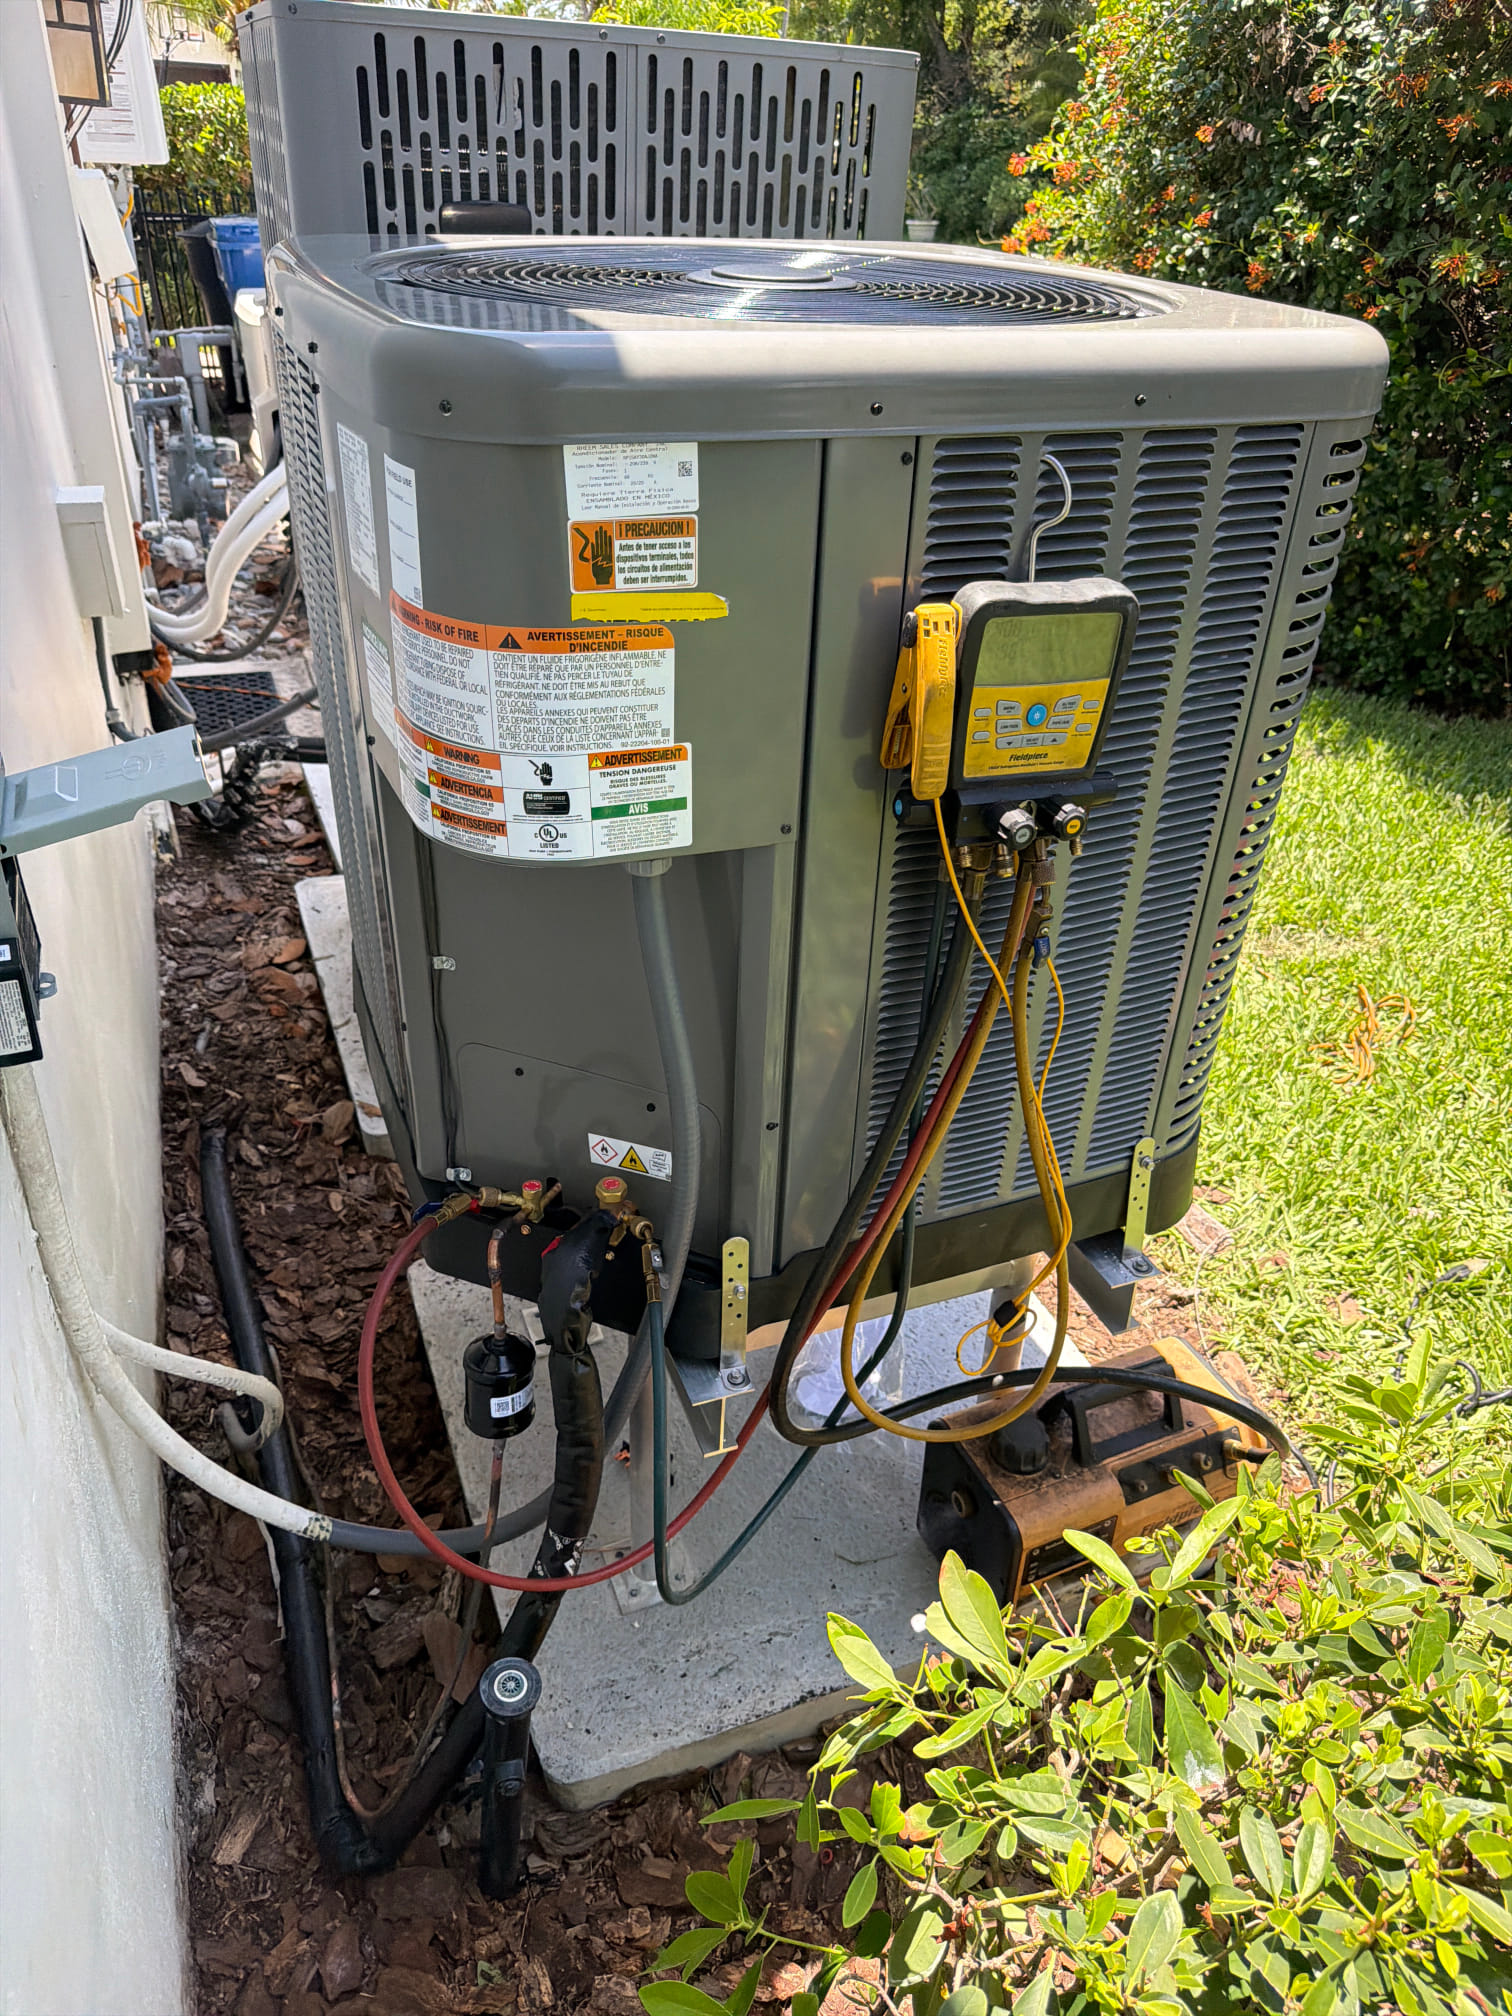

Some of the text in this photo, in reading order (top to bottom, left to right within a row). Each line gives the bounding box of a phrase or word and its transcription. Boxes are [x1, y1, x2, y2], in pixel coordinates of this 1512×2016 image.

[624, 521, 684, 538] PRECAUCION
[618, 543, 634, 552] Antes
[636, 542, 642, 550] de
[644, 542, 657, 550] tener
[658, 542, 677, 550] acceso
[683, 540, 691, 548] los
[616, 553, 648, 564] dispositivos
[680, 551, 694, 560] todos
[618, 562, 692, 574] los circuitos de alimentación
[623, 573, 688, 584] deben ser interrumpidos.
[425, 619, 442, 634] RISK
[444, 625, 456, 637] OF
[458, 628, 480, 643] FIRE
[527, 628, 664, 642] AVERTISSEMENT RISQUE
[448, 644, 474, 659] REPAIRED
[569, 640, 628, 653] D'INCENDIE
[449, 656, 457, 667] DO
[458, 658, 470, 670] NOT
[492, 652, 526, 664] CONTIENT
[528, 655, 538, 664] UN
[540, 655, 563, 664] FLUIDE
[658, 650, 667, 658] NE
[494, 662, 509, 670] DOIT
[554, 664, 570, 673] QUE
[570, 664, 583, 672] PAR
[596, 662, 633, 671] PERSONNEL
[458, 670, 464, 680] OF
[494, 670, 508, 678] TIEN
[554, 672, 566, 680] PAS
[568, 672, 592, 680] PERCER
[593, 671, 600, 680] LE
[602, 670, 622, 679] TUYAU
[624, 670, 632, 678] DE
[468, 682, 488, 695] LOCAL
[542, 682, 550, 690] NE
[552, 682, 568, 690] DOIT
[587, 680, 598, 689] MIS
[600, 680, 610, 688] AU
[610, 680, 630, 688] REBUT
[632, 678, 646, 688] QUE
[495, 689, 552, 700] CONFORMÉMENT
[554, 692, 568, 700] AUX
[510, 708, 544, 717] APPAREILS
[545, 709, 576, 717] ANNEXES
[576, 708, 588, 716] QUI
[590, 706, 618, 715] PEUVENT
[620, 704, 658, 713] CONSTITUER
[497, 715, 510, 724] DES
[580, 716, 588, 725] NE
[590, 715, 618, 724] DOIVENT
[620, 713, 631, 722] PAS
[468, 722, 480, 734] USE
[523, 726, 542, 734] DANS
[543, 726, 554, 734] LES
[556, 726, 592, 734] CONDUITES
[594, 722, 632, 733] D'APPAREILS
[634, 720, 662, 730] ANNEXES
[499, 732, 521, 742] AUTRES
[522, 734, 536, 744] QUE
[538, 735, 554, 744] CEUX
[556, 735, 564, 743] DE
[566, 734, 574, 742] LA
[575, 734, 590, 742] LISTE
[592, 730, 633, 741] CONCERNANT
[500, 742, 508, 750] EIL
[550, 744, 564, 752] VOIR
[604, 748, 682, 766] ADVERTISSEMENT
[1009, 752, 1048, 762] Fieldpiece
[600, 764, 676, 778] TENSION DANGEREUSE
[440, 776, 494, 800] ADVERTENCIA
[628, 802, 648, 815] AVIS
[440, 808, 505, 834] ADVERTISSEMENT
